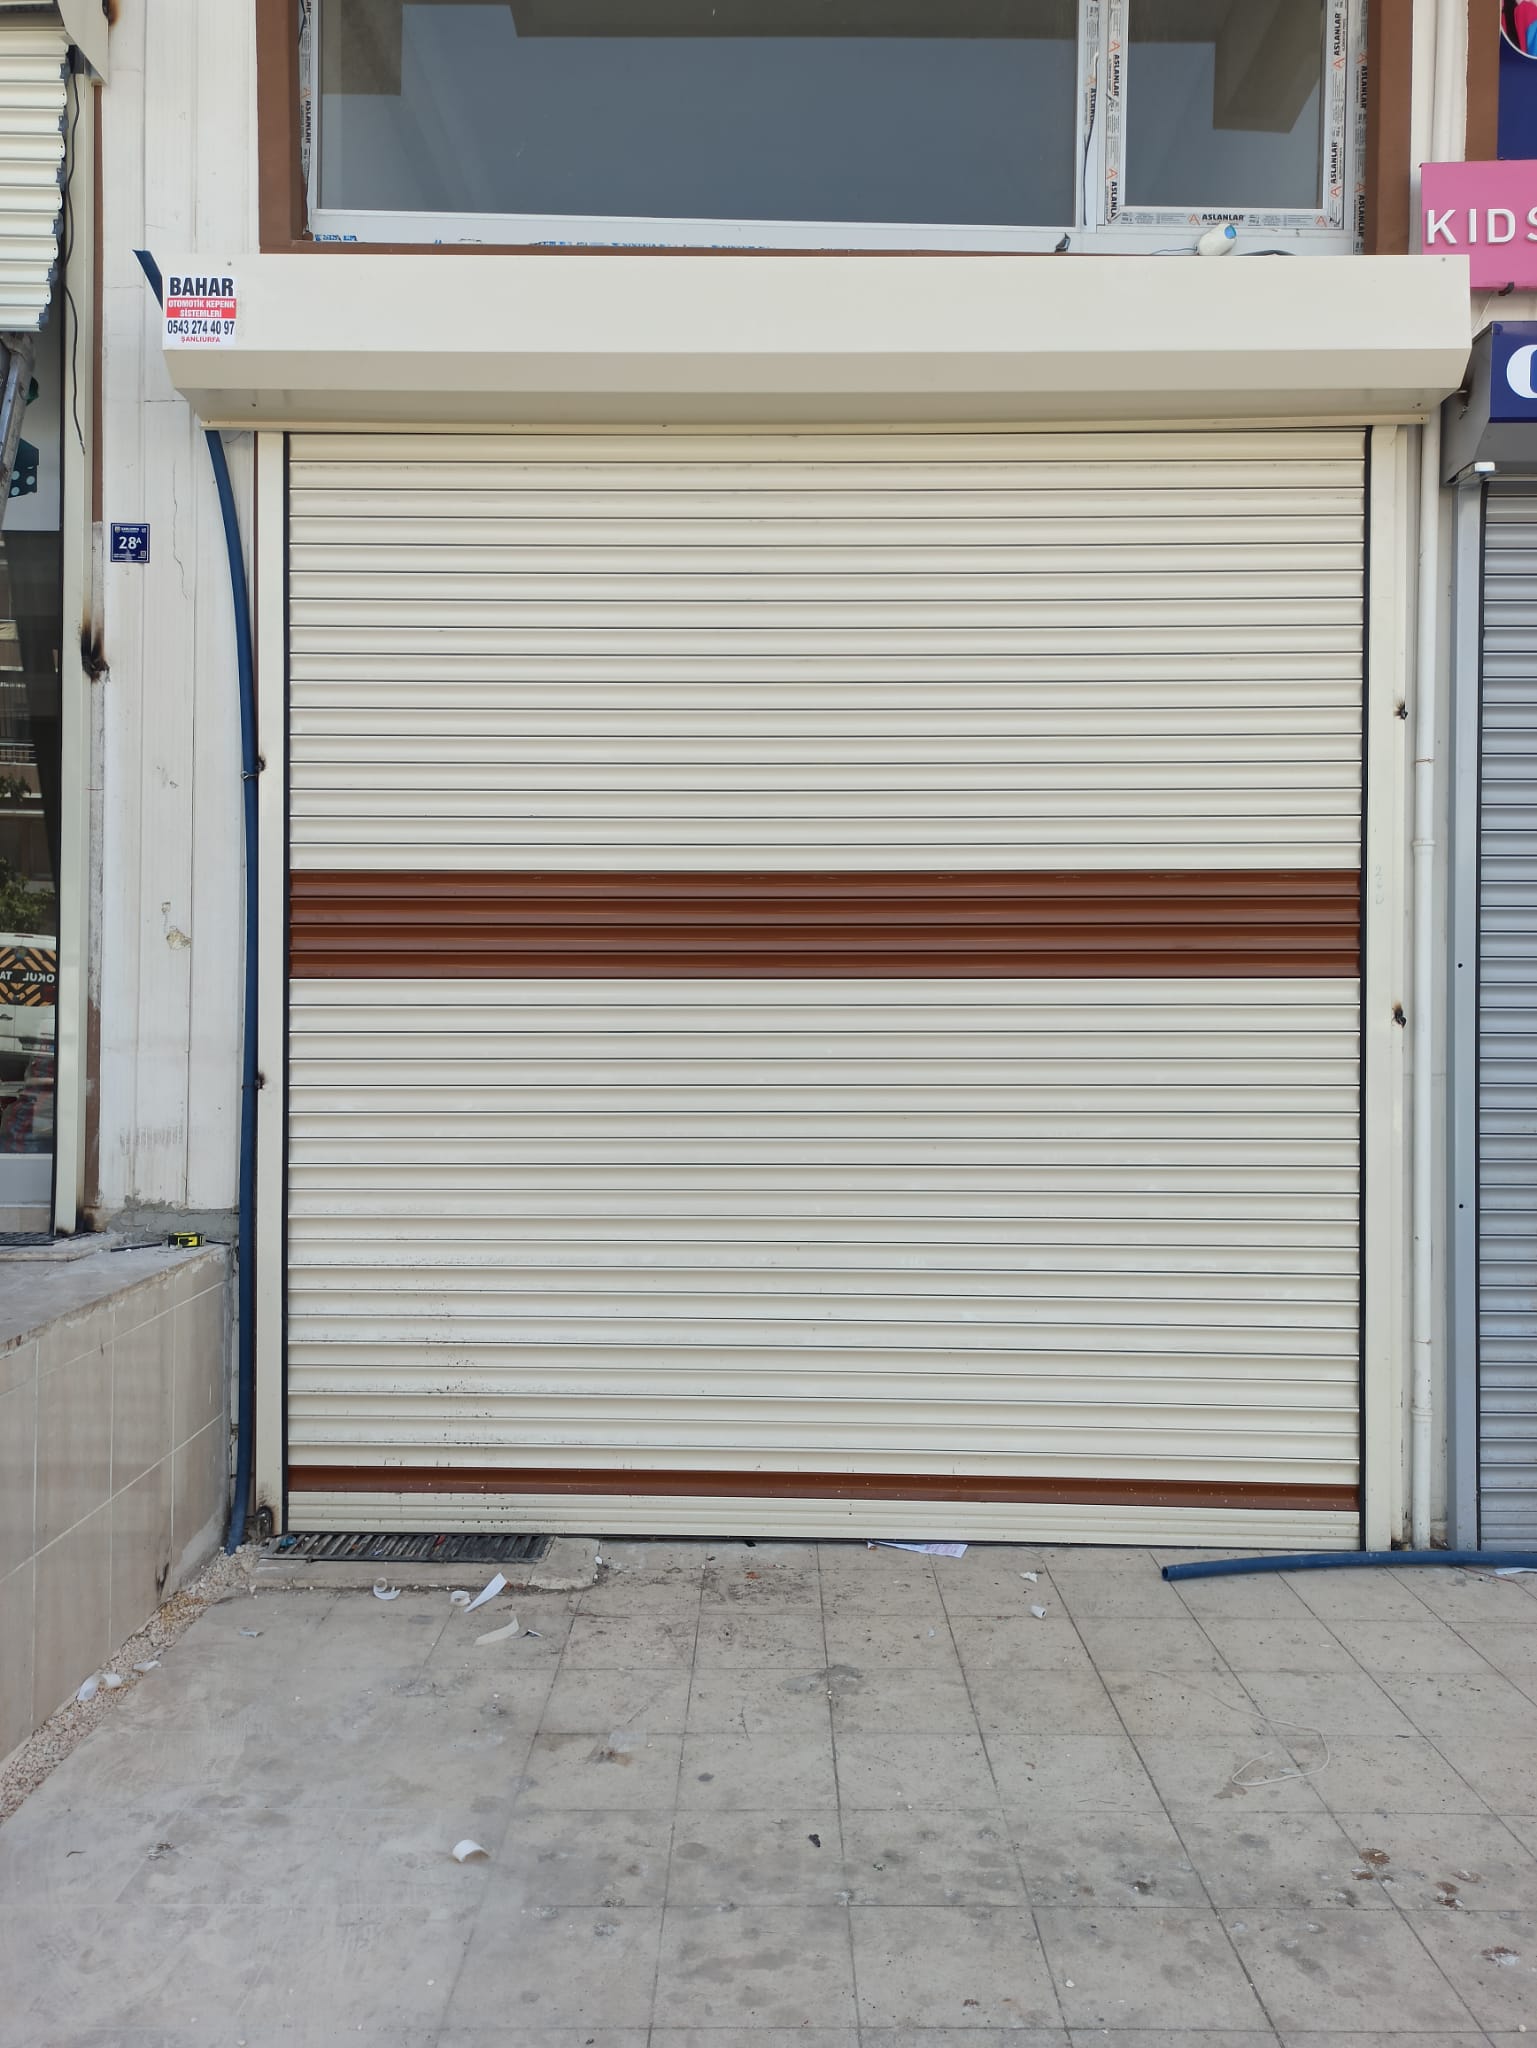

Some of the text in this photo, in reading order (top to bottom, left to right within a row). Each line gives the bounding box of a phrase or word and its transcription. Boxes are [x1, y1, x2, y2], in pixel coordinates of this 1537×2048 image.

[1333, 12, 1342, 56] ASLANLAR
[1112, 54, 1120, 96] ASLANLAR
[1360, 65, 1368, 109] ASLANLAR
[1330, 141, 1338, 184] ASLANLAR
[1357, 194, 1366, 237] ASLANLAR
[168, 299, 235, 308] OTOMOTİK KEPENK
[169, 277, 234, 297] BAHAR
[167, 320, 235, 335] 0543 274 40 97
[180, 309, 222, 317] SİSTEMLERİ
